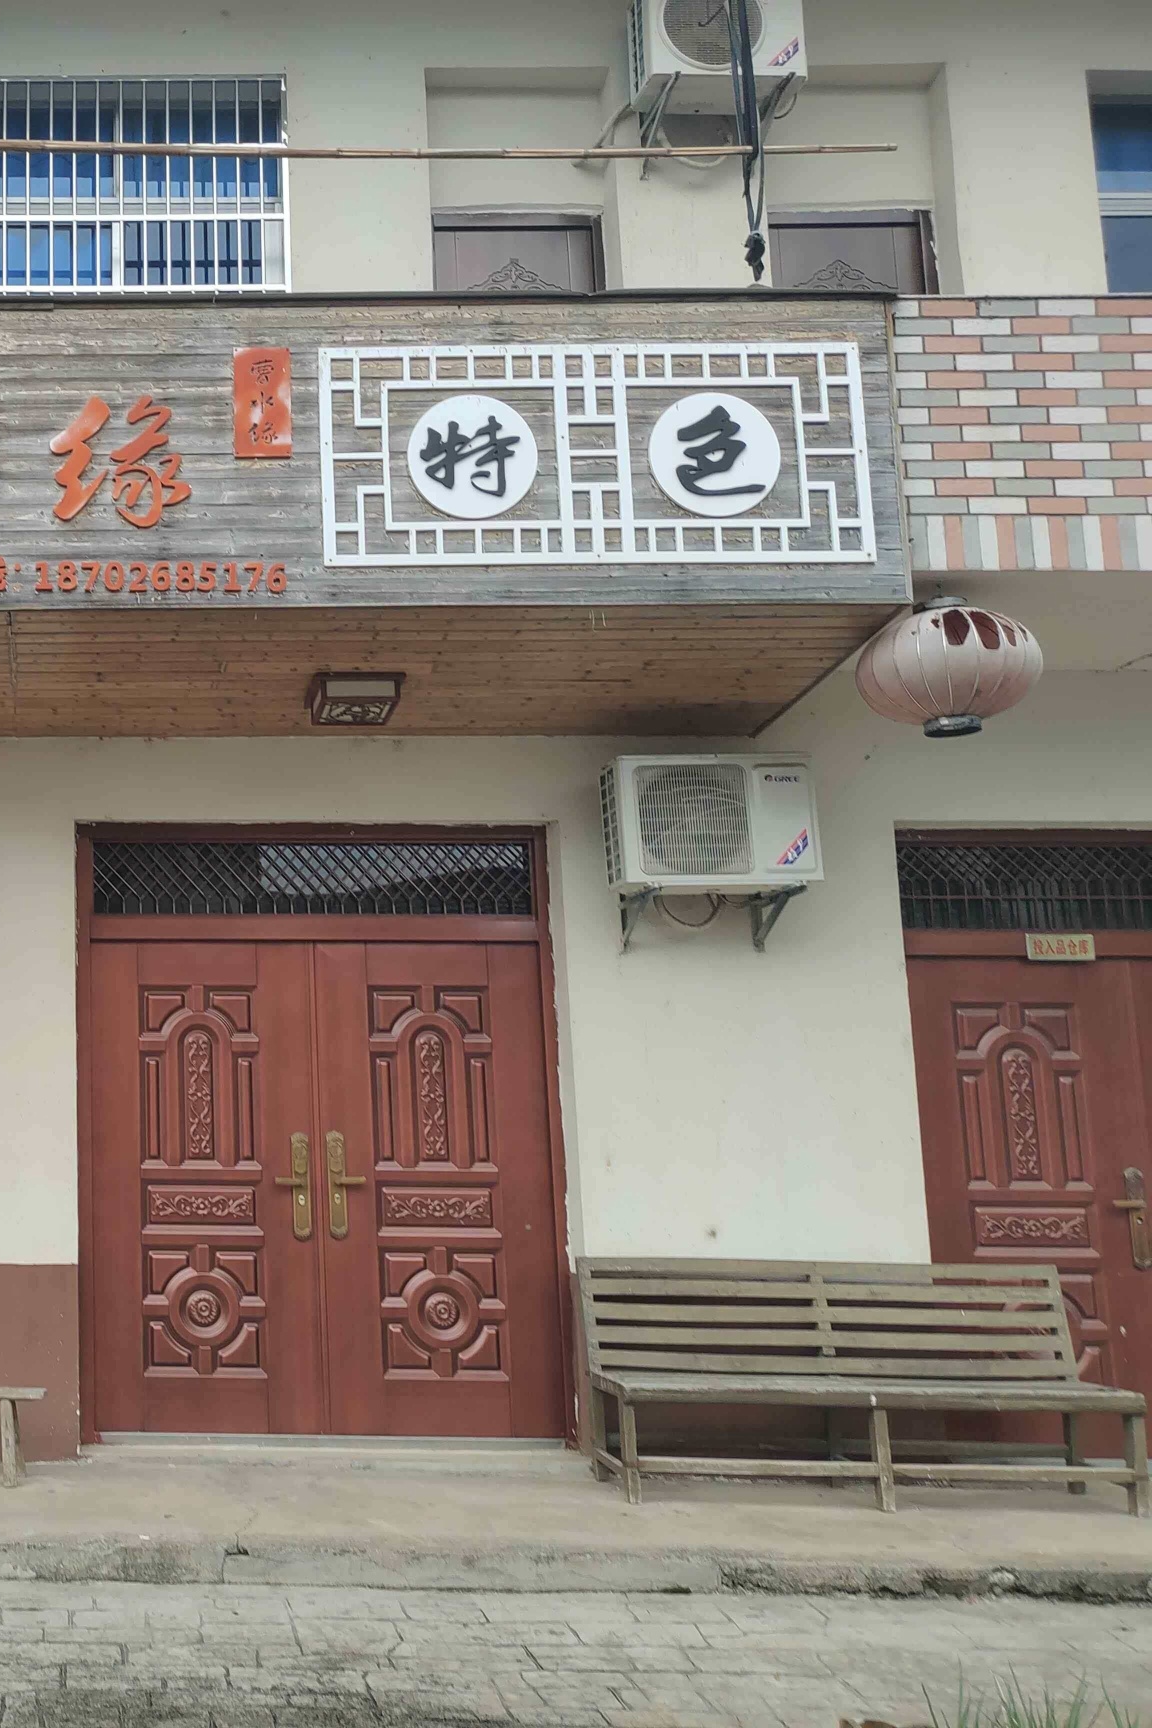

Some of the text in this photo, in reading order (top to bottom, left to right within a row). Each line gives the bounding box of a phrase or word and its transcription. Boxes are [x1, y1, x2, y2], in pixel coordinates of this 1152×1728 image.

[419, 405, 767, 497] 特色
[1033, 938, 1089, 955] 投入品仓库
